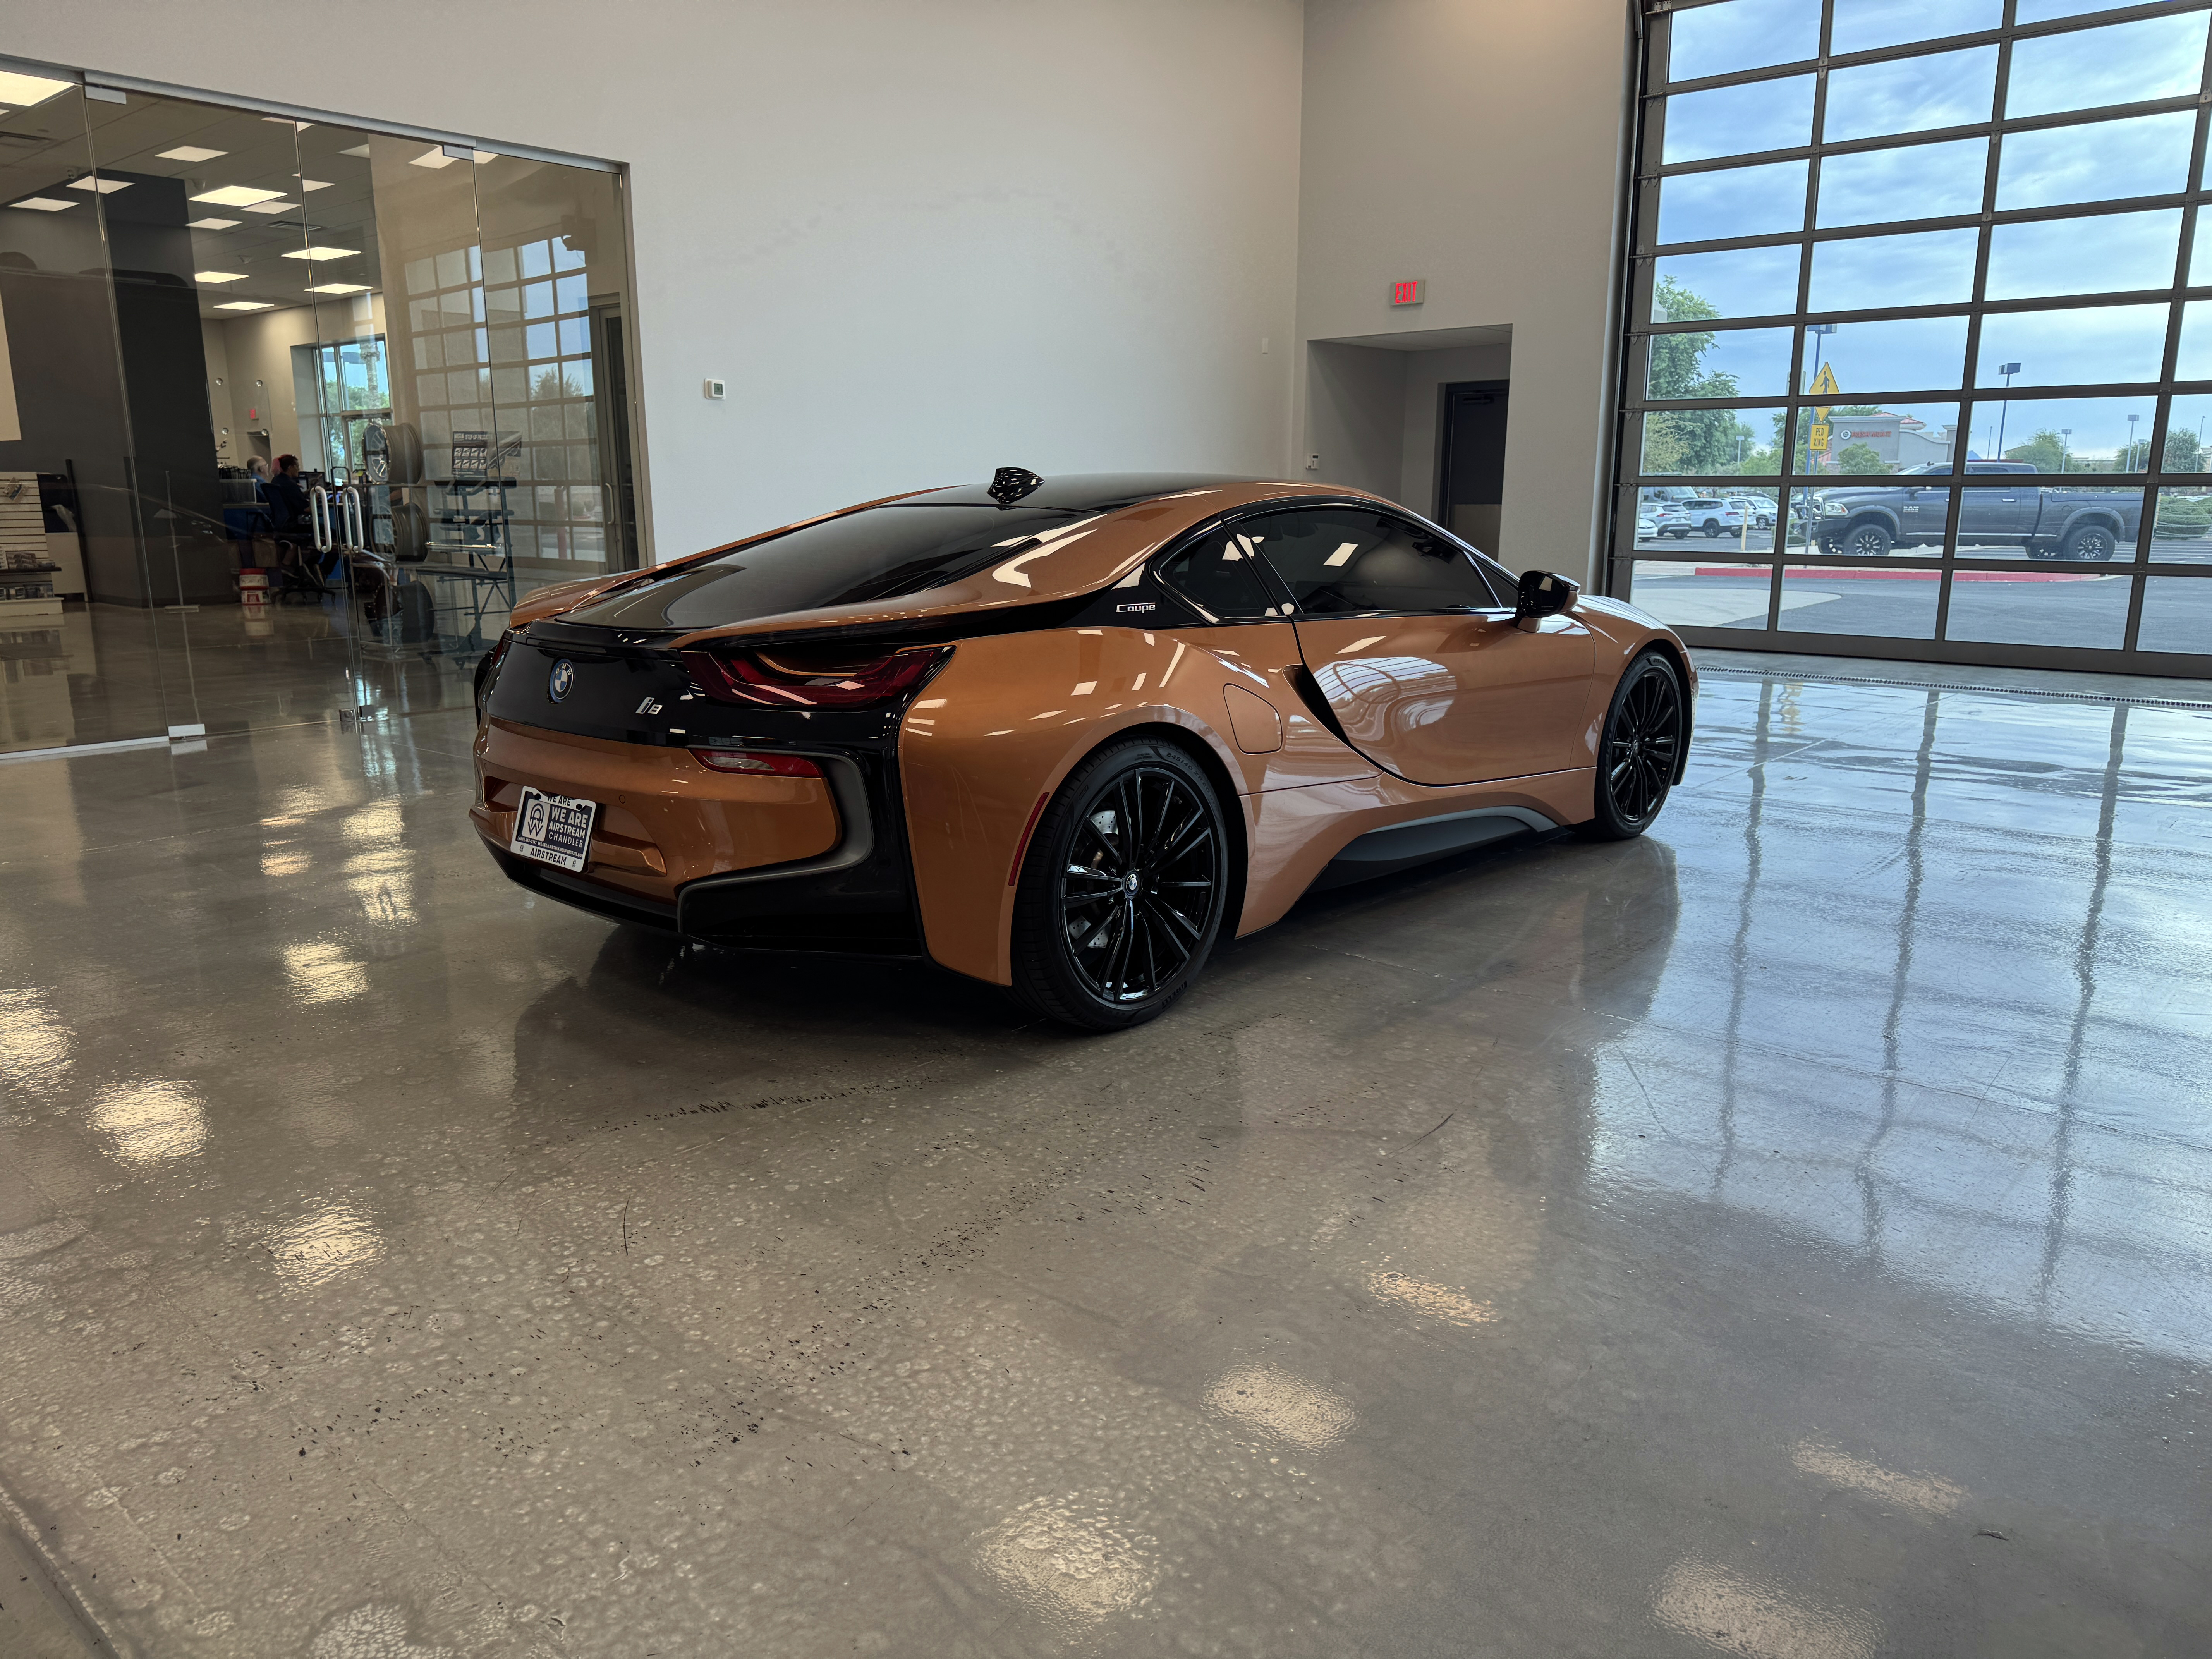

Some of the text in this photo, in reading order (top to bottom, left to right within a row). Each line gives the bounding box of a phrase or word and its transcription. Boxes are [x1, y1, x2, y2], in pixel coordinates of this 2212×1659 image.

[1395, 281, 1418, 304] EXIT
[1815, 428, 1824, 436] PED
[1814, 438, 1824, 447] XING
[1116, 603, 1156, 613] Coupe
[635, 697, 663, 715] i8
[558, 795, 571, 806] ARE
[552, 806, 588, 828] WE ARE
[549, 821, 586, 839] AIRSTREAM
[549, 832, 583, 848] CHANDLER
[530, 847, 567, 866] AIRSTREAM
